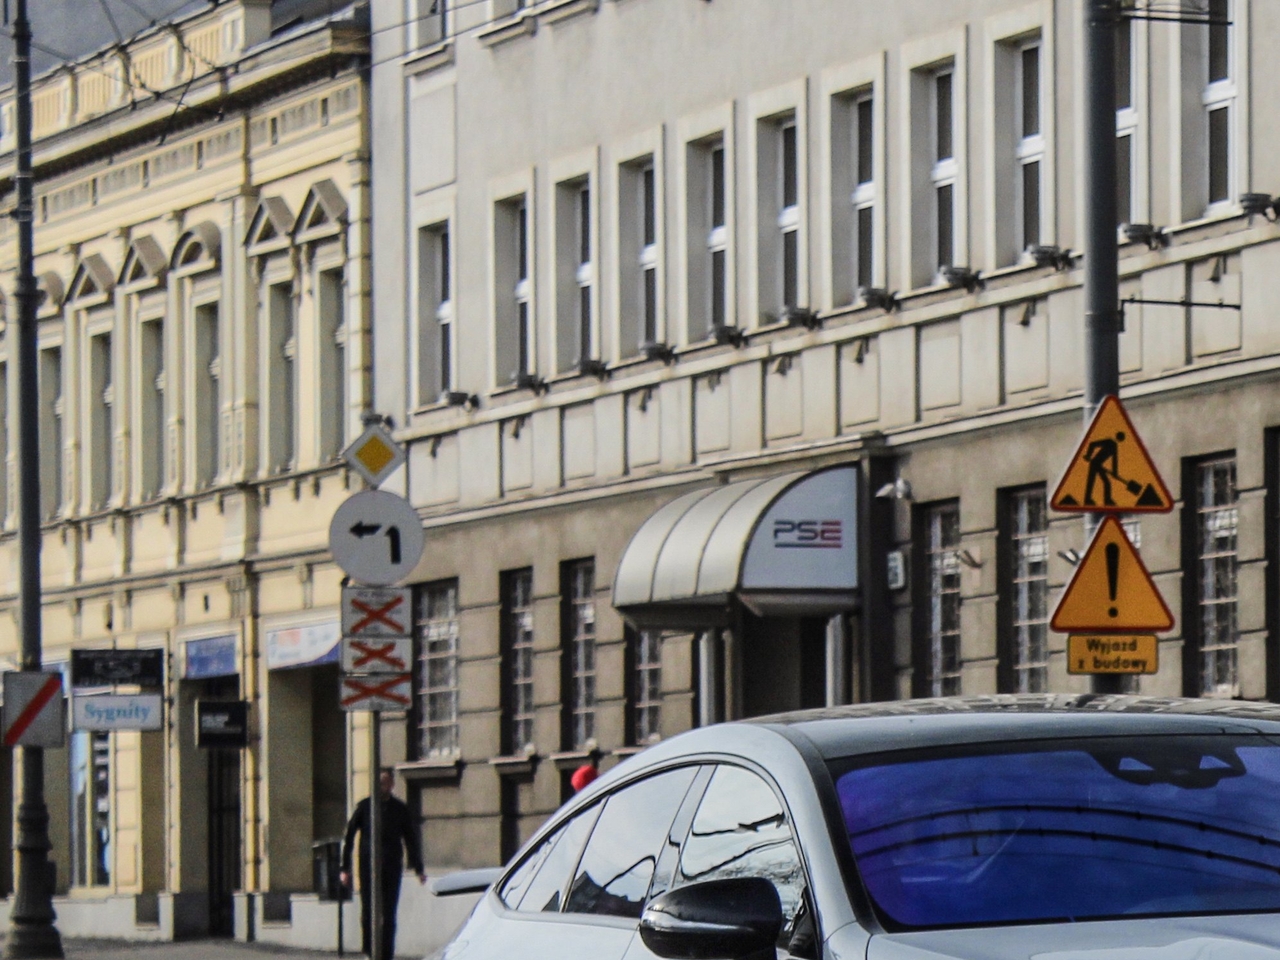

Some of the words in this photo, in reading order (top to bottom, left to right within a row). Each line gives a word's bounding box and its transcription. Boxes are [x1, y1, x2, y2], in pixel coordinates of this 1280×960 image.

[773, 520, 842, 541] PSE
[1086, 639, 1137, 655] Wyjazd
[1093, 656, 1147, 672] budowy
[84, 701, 150, 722] Sygnity
